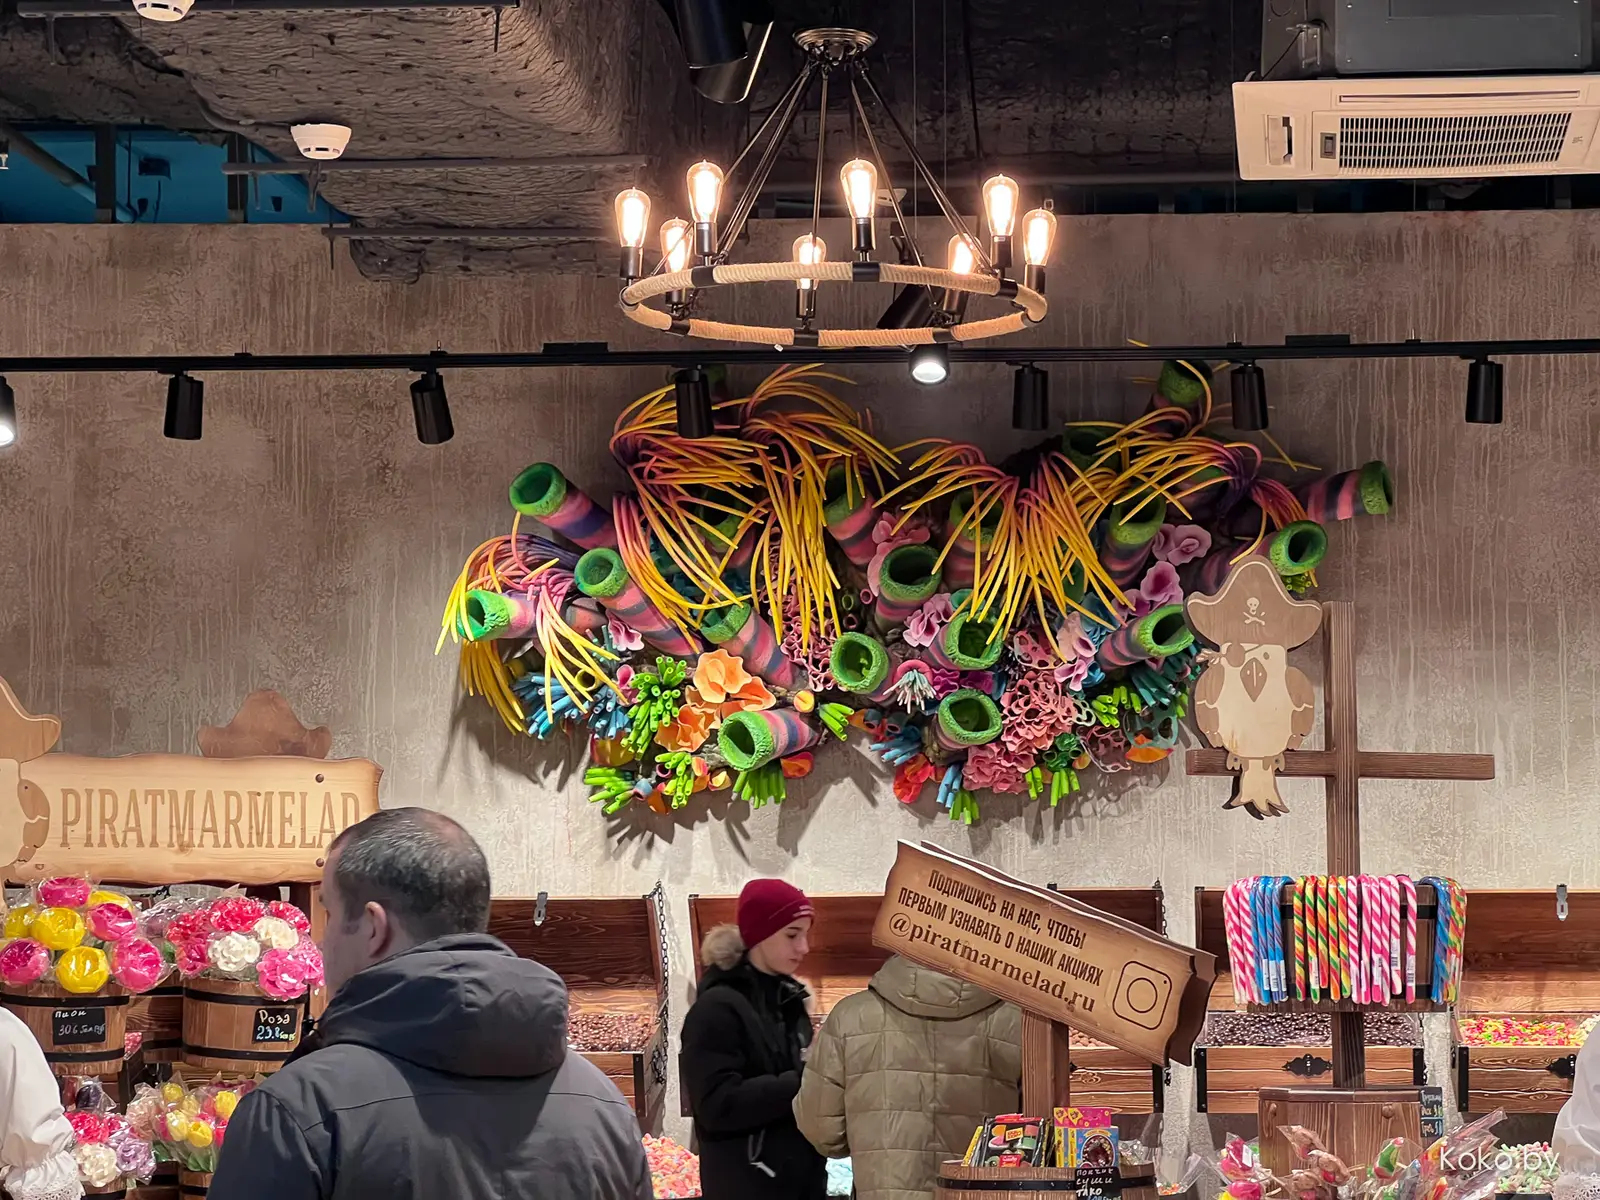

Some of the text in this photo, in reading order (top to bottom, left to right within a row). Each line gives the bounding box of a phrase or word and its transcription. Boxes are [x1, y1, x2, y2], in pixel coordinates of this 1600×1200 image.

[898, 887, 1105, 987] ПЕРВЫМ УЗНАВАТЬ О НАШИХ АКЦИЯХ
[928, 869, 1087, 950] ПОДПИШИСЬ НА НАС, ЧТОБЫ
[889, 912, 1097, 1013] @piratmarmelad.ru
[259, 1010, 290, 1024] Роза
